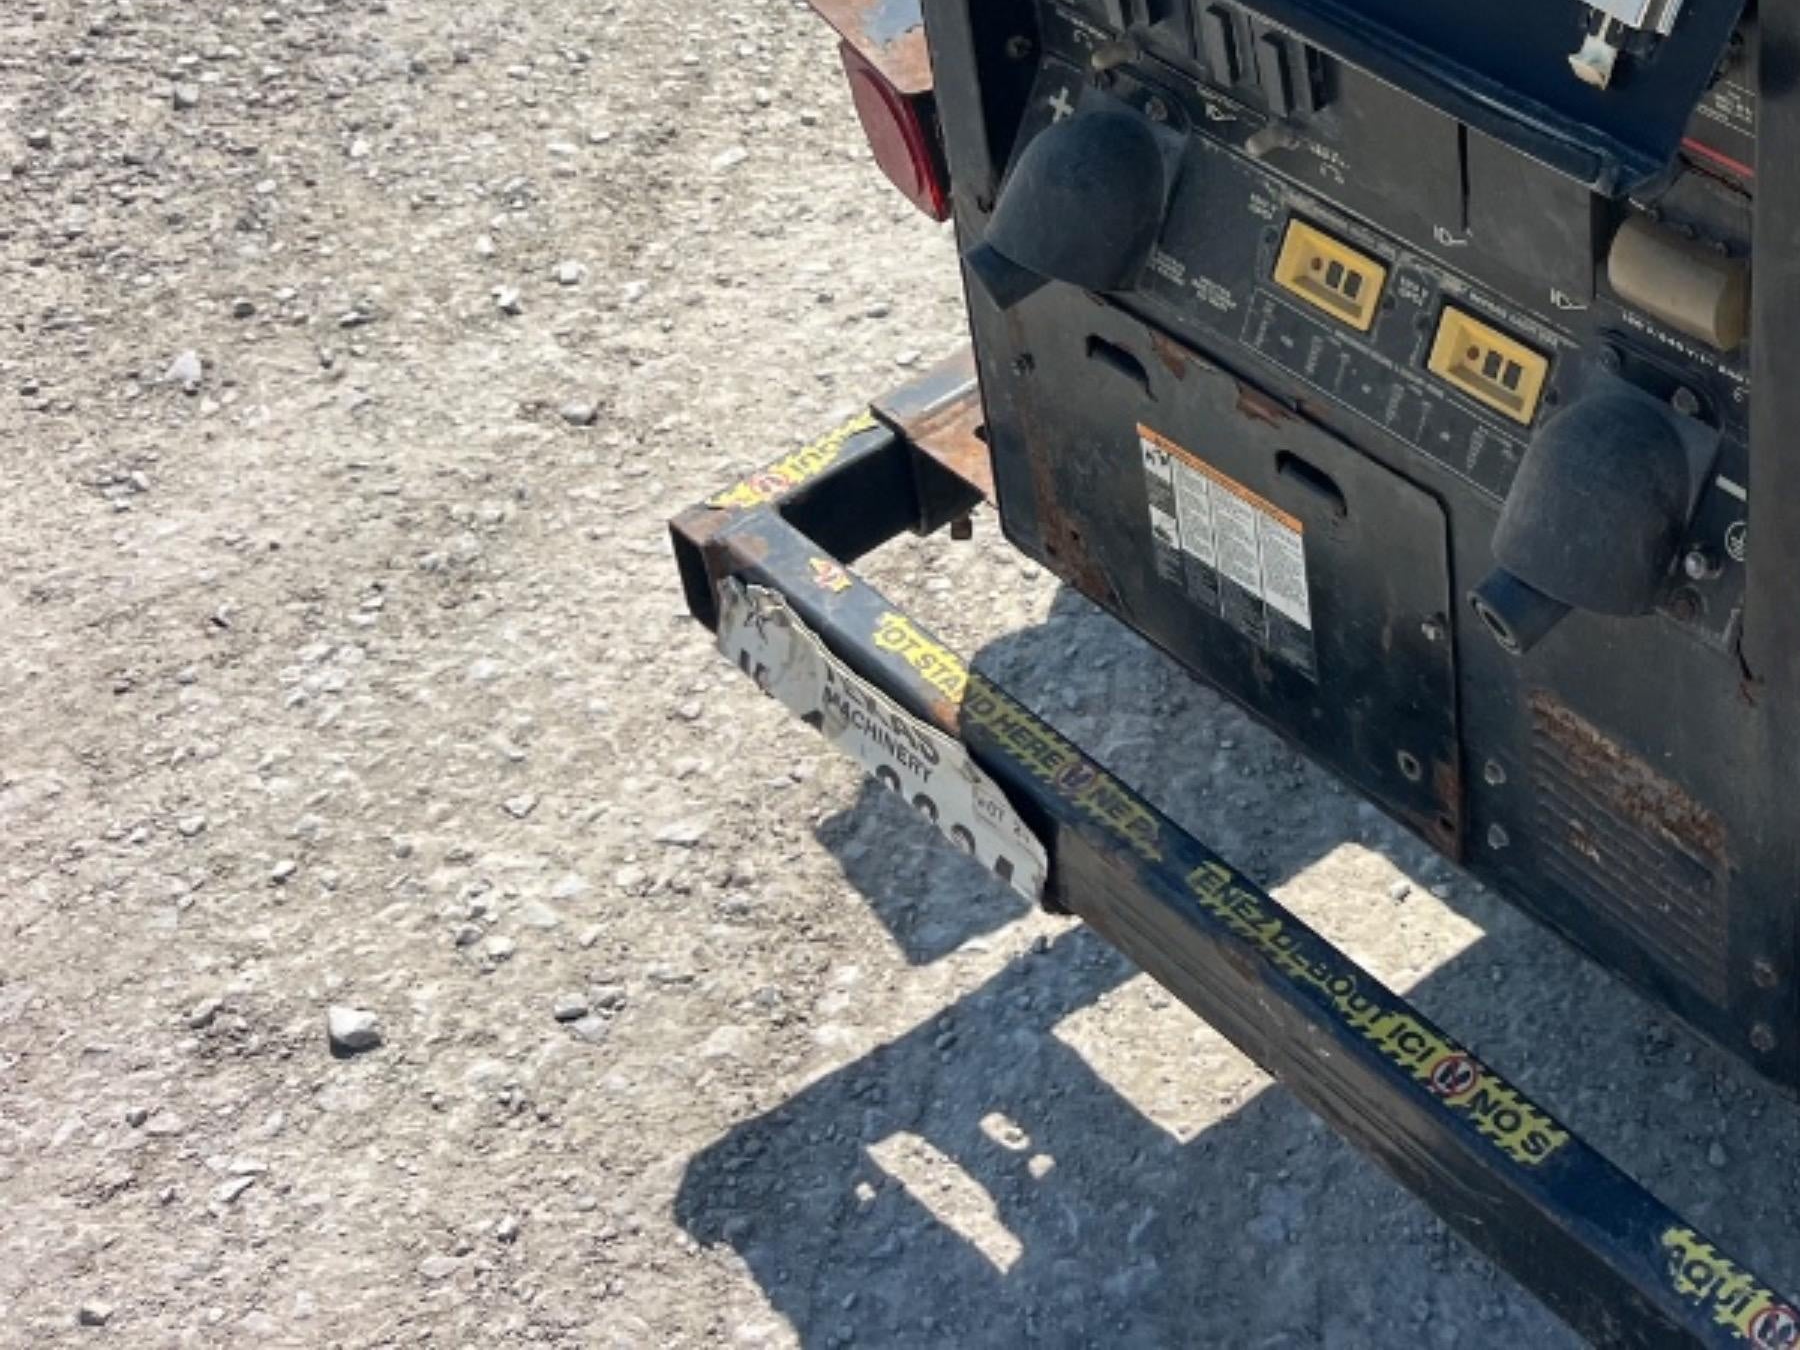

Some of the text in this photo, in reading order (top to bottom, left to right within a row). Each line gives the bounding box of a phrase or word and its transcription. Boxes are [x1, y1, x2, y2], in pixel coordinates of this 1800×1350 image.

[822, 686, 934, 783] MACHINERY
[995, 708, 1065, 774] HERE
[1388, 1022, 1436, 1062] ICI
[1468, 1088, 1522, 1133] NO
